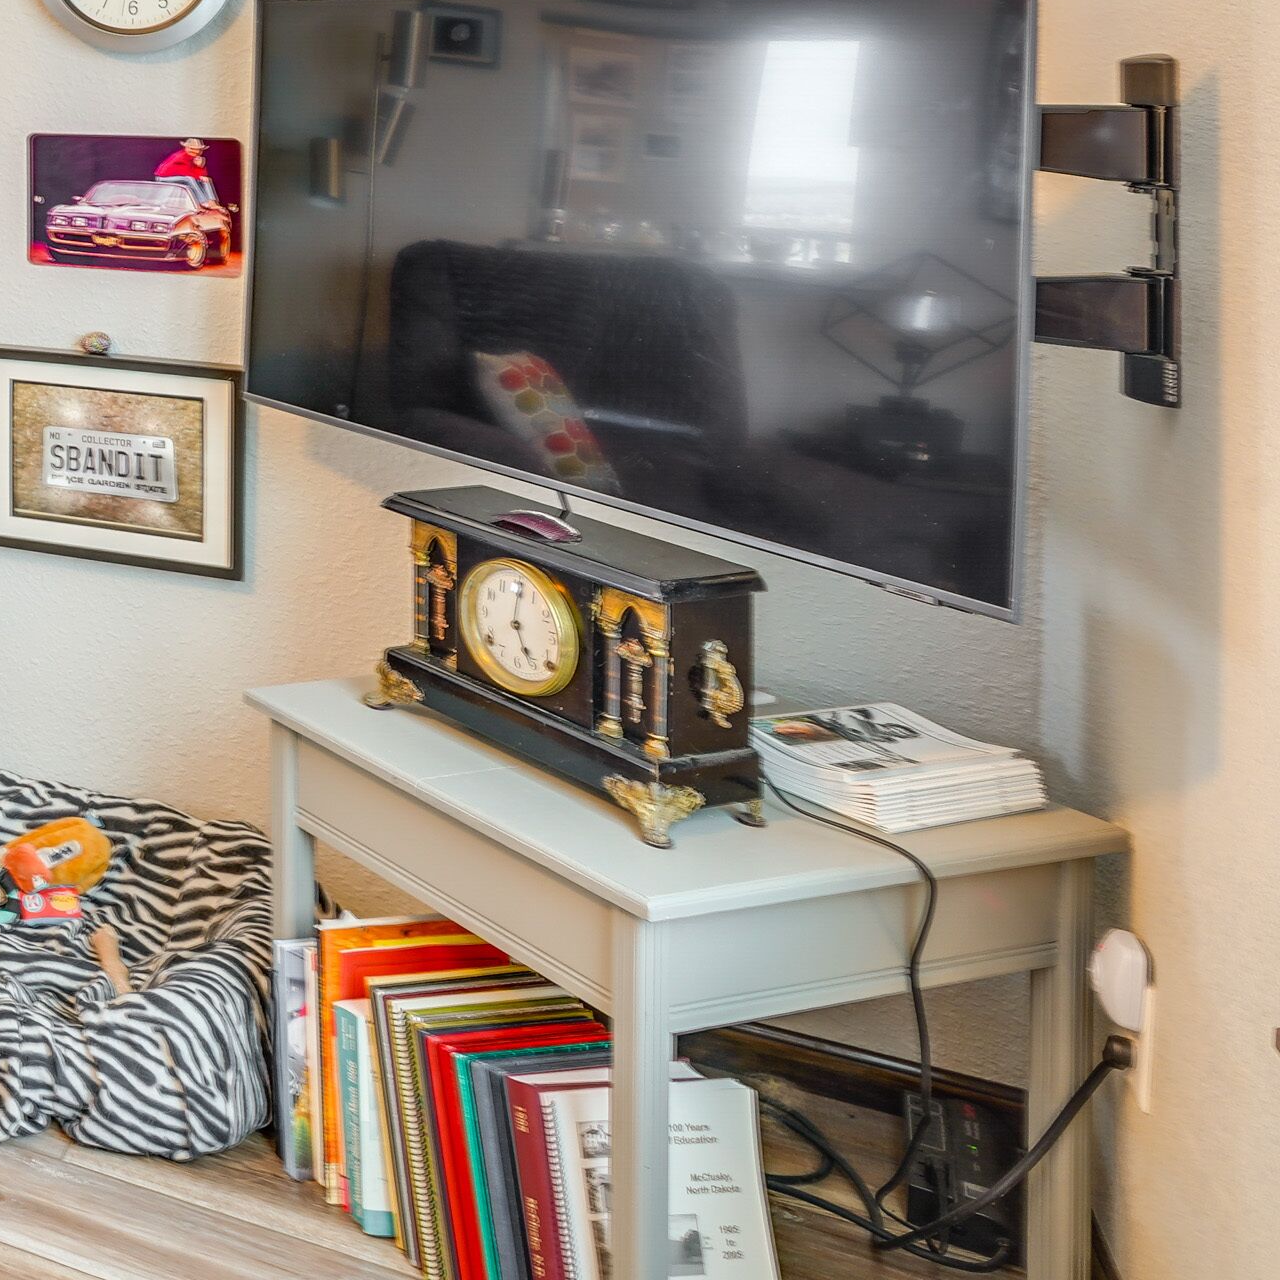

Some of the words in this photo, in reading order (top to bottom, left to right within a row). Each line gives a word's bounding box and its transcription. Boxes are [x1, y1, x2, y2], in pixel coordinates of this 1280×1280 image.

[128, 0, 139, 16] 6
[81, 434, 132, 447] COLLECTOR
[50, 444, 164, 482] SBANDIT
[499, 579, 506, 593] 11
[487, 587, 496, 602] 10
[513, 657, 522, 669] 6
[684, 1122, 711, 1132] Years
[673, 1134, 719, 1145] Education
[686, 1187, 709, 1195] North
[710, 1185, 741, 1194] Dakota
